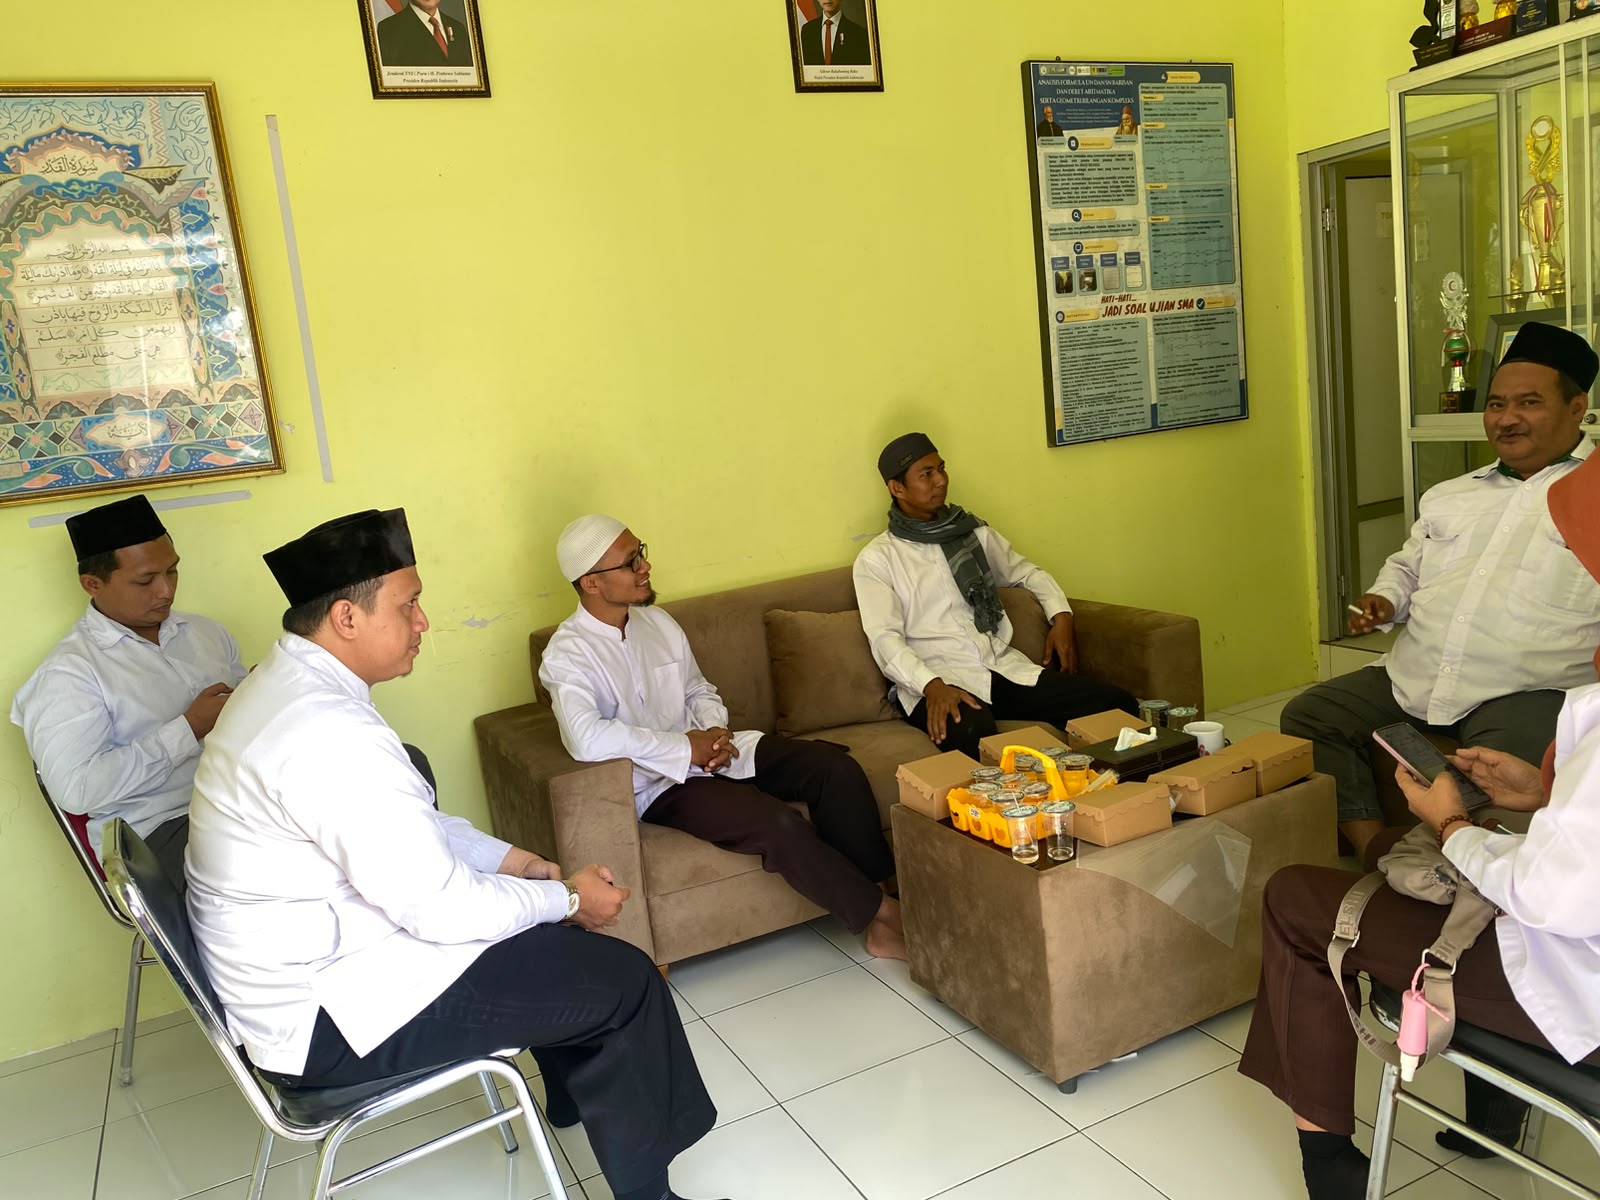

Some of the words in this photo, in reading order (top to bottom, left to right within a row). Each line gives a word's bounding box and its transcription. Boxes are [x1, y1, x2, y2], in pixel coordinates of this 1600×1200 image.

[1102, 305, 1122, 317] JADI
[1125, 302, 1147, 315] SOAL
[1150, 300, 1176, 312] UJIAN
[1177, 298, 1194, 310] SMA
